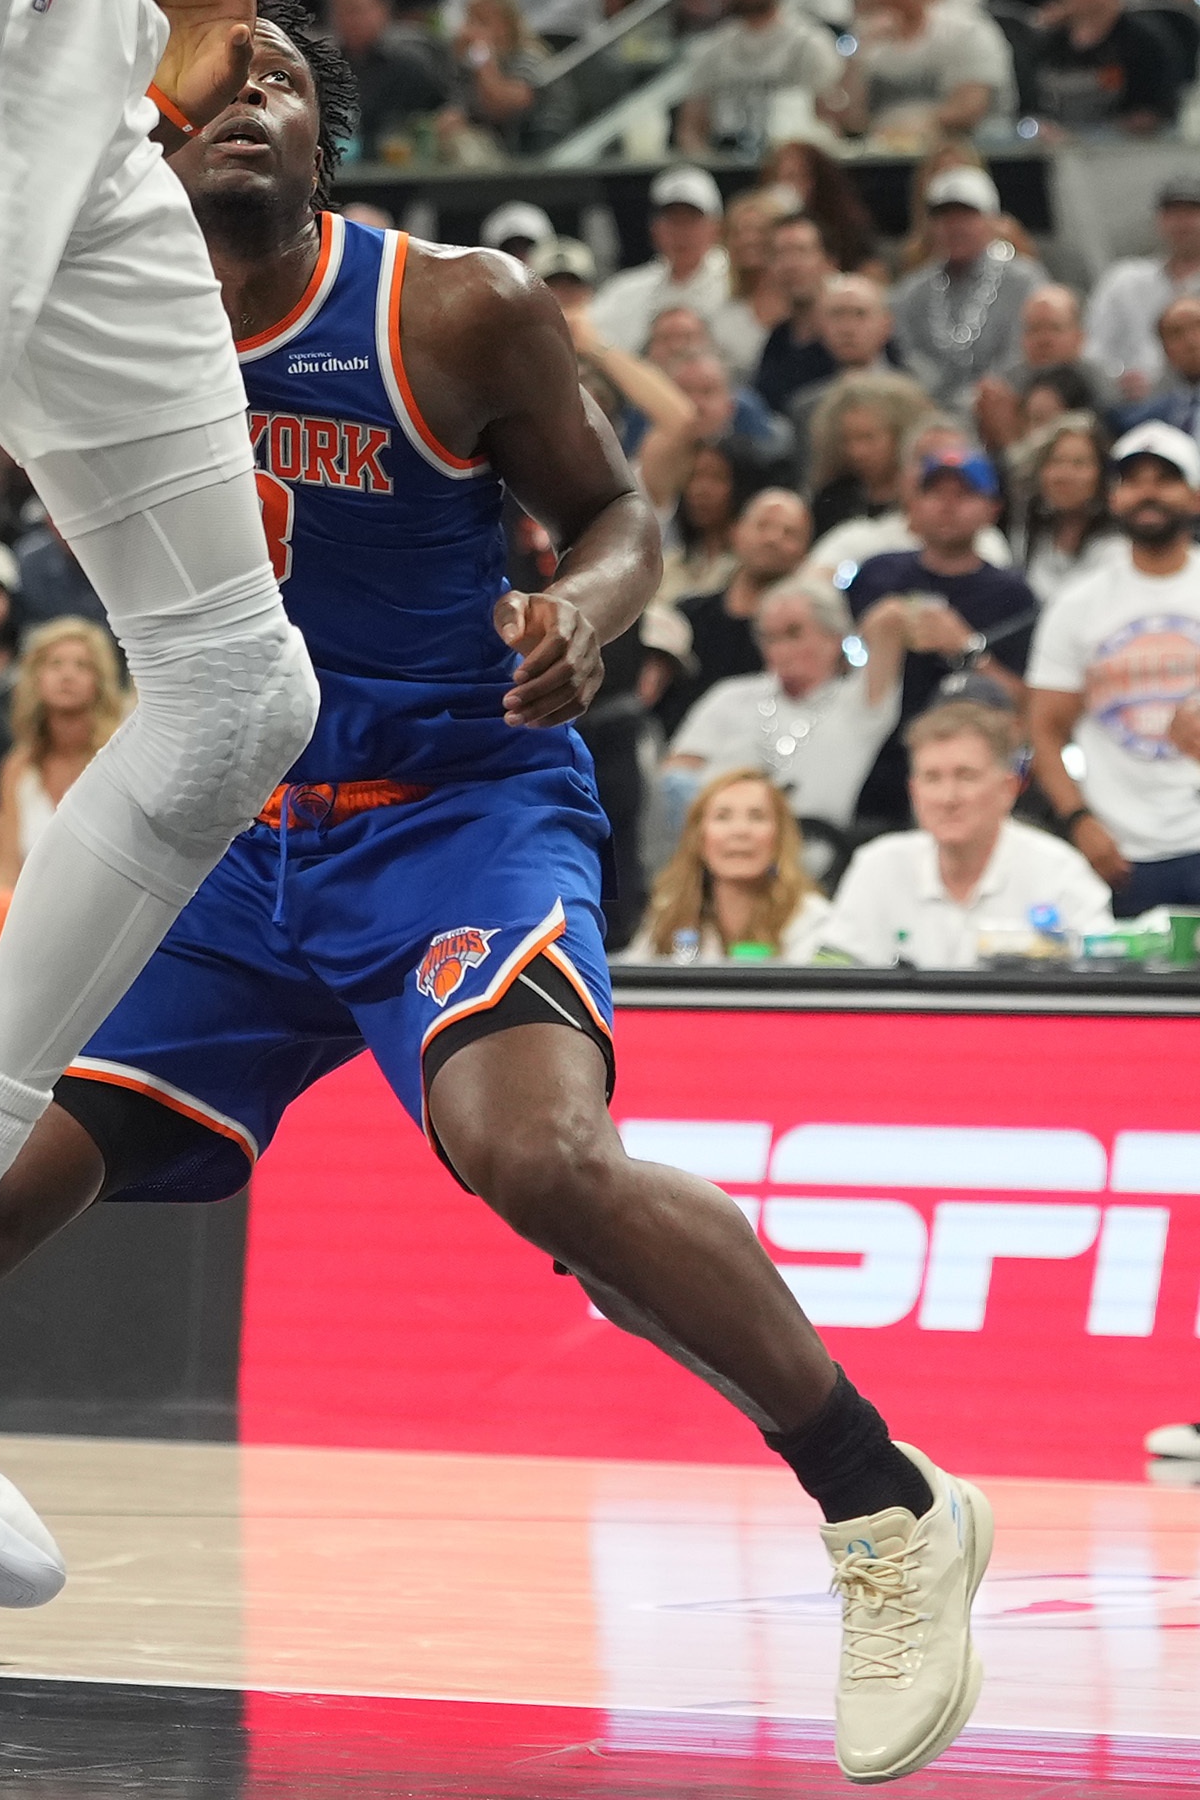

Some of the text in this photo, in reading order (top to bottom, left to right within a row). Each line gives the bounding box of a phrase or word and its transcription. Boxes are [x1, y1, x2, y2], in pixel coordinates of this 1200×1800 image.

[287, 355, 369, 374] abu dhabi
[288, 351, 332, 361] experience
[419, 929, 488, 991] KNICKS
